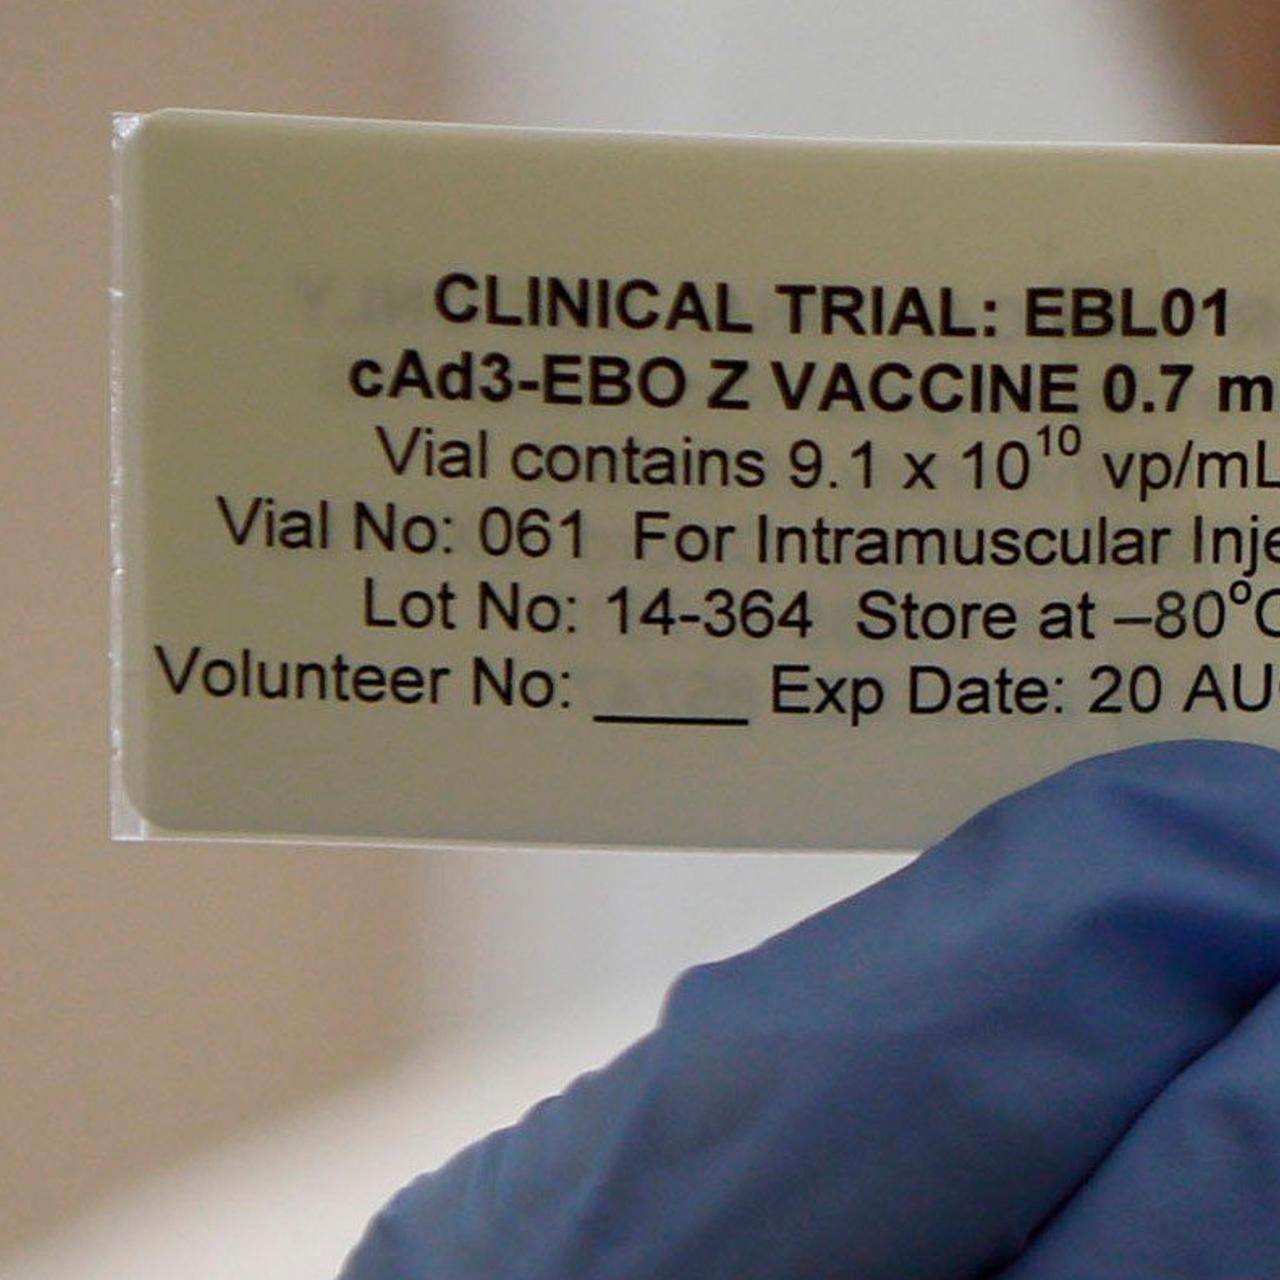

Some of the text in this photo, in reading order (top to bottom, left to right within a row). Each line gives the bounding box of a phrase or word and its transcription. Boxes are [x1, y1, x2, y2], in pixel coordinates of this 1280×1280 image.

[434, 273, 753, 334] CLINICAL
[775, 284, 996, 337] TRIAL:
[1026, 287, 1227, 337] EBL01
[348, 349, 687, 408] cAd3-EBO
[707, 360, 750, 410] Z
[771, 361, 1079, 413] VACCINE
[1103, 364, 1194, 413] 0.7
[375, 426, 487, 478] Vial
[511, 436, 765, 488] contains
[789, 439, 872, 489] 9.1
[903, 453, 936, 490] x
[216, 496, 329, 549] Vial
[354, 501, 452, 554] No:
[479, 506, 581, 558] 061
[635, 511, 736, 562] For
[759, 514, 1172, 566] Intramuscular
[365, 577, 456, 630] Lot
[479, 581, 576, 633] No:
[608, 586, 813, 639] 14-364
[857, 590, 1017, 640] Store
[1039, 592, 1096, 640] at
[154, 645, 451, 704] Volunteer
[473, 657, 570, 708] No:
[773, 664, 884, 727] Exp
[909, 666, 1063, 715] Date:
[1088, 665, 1162, 714] 20
